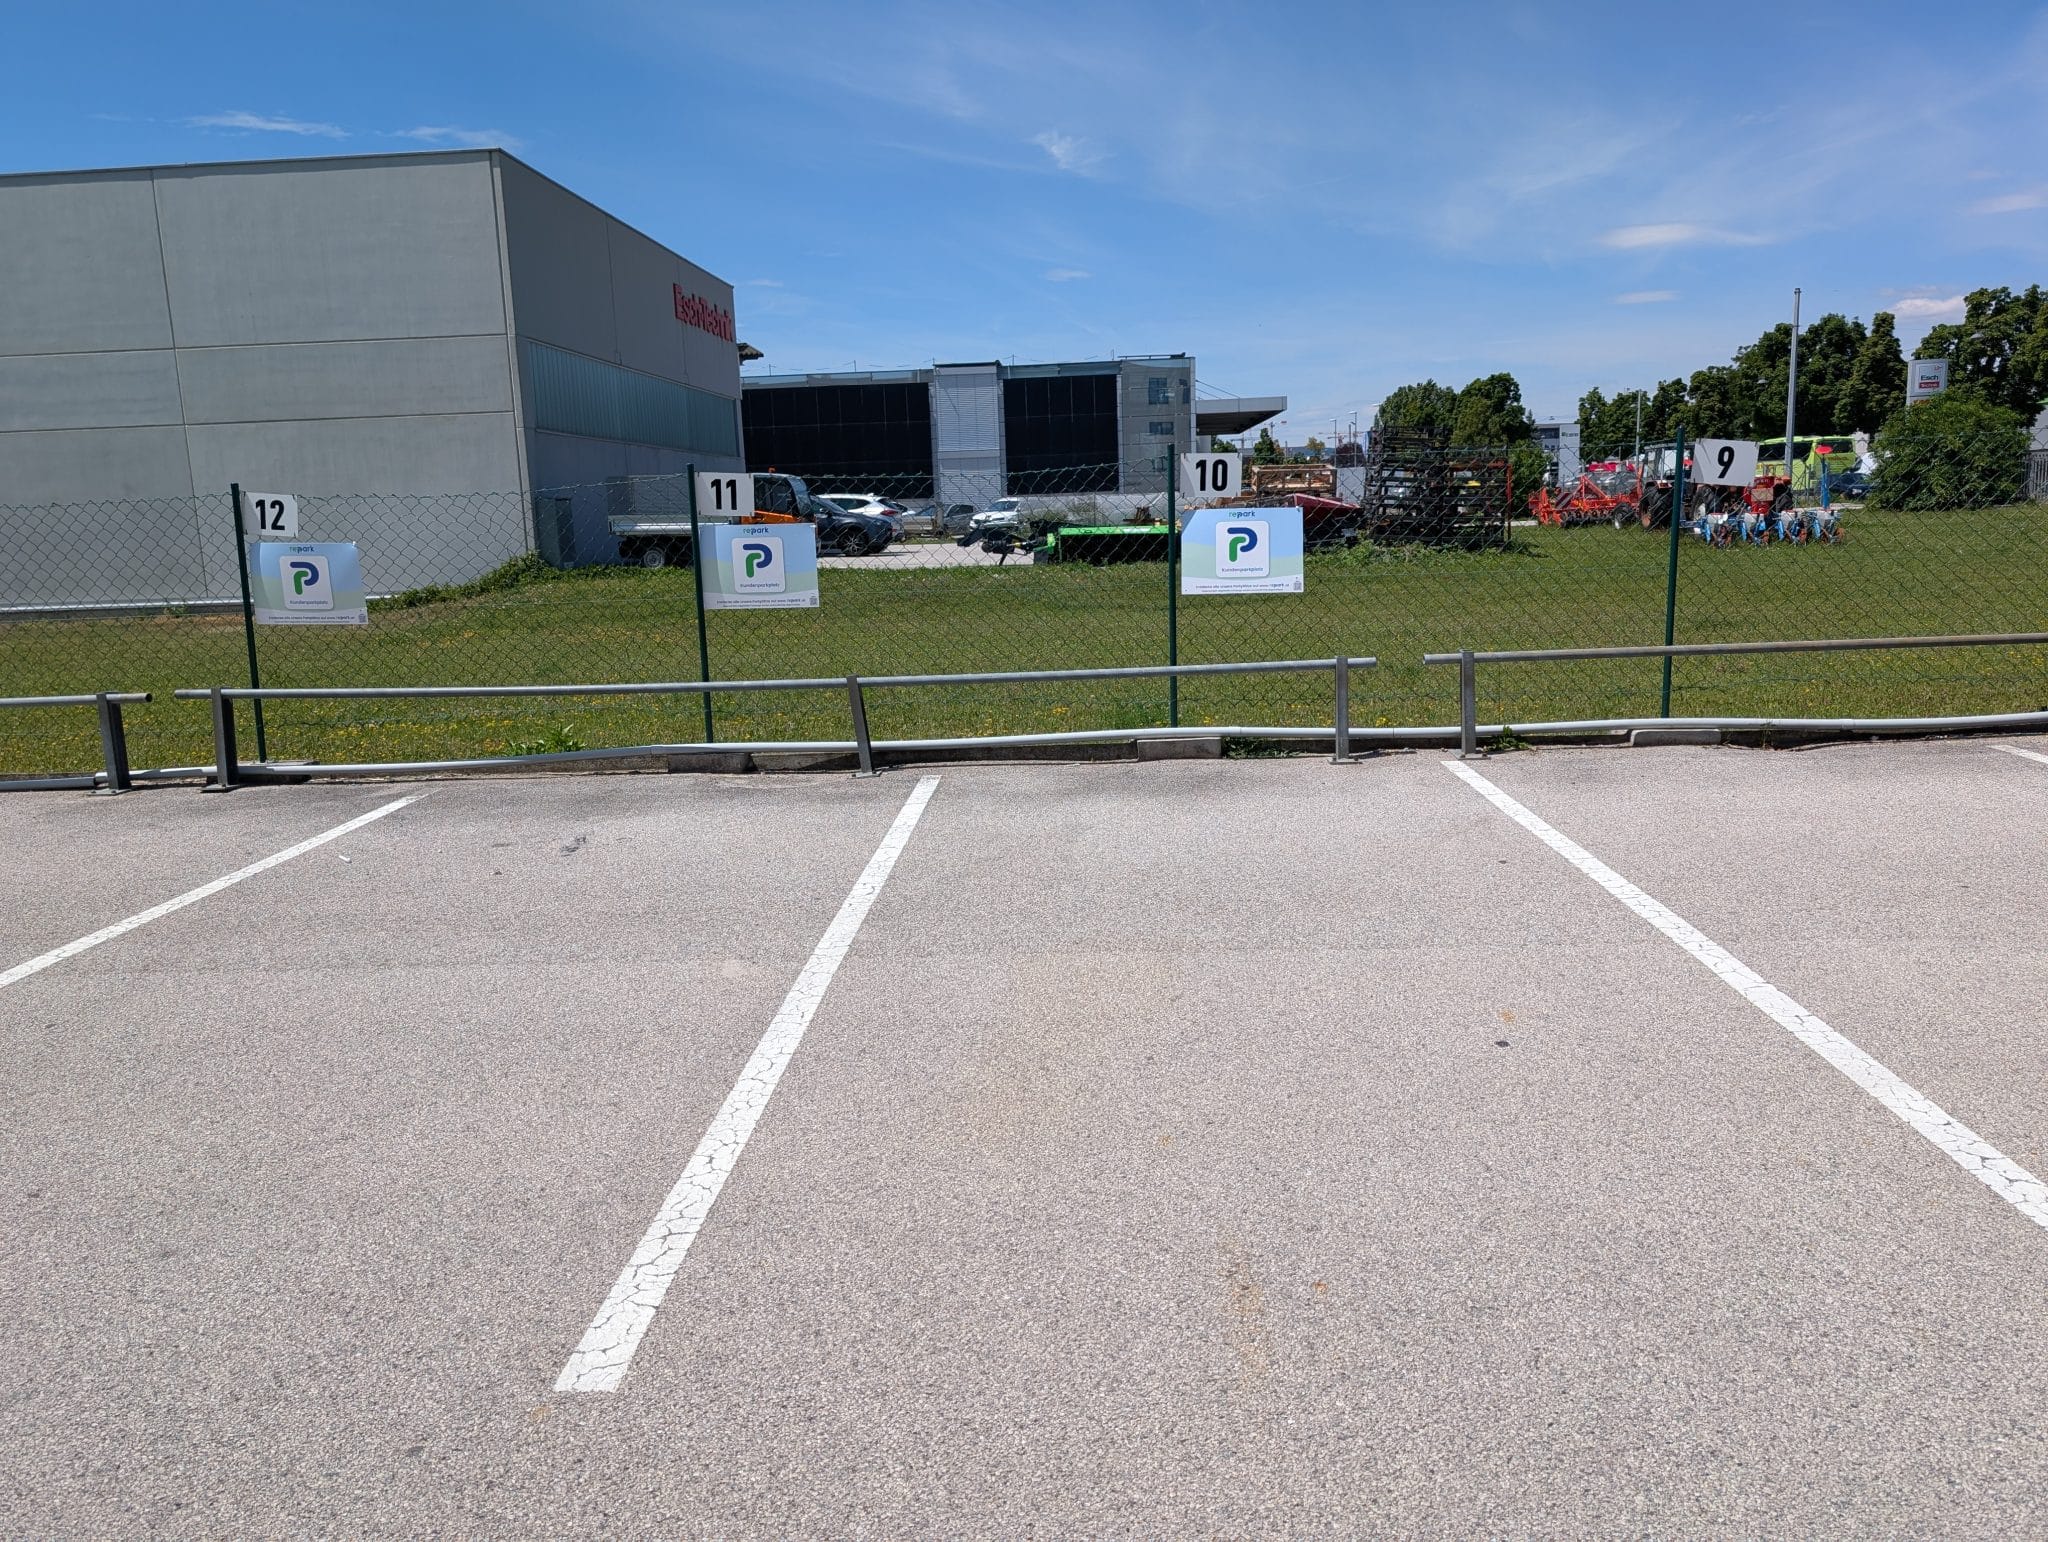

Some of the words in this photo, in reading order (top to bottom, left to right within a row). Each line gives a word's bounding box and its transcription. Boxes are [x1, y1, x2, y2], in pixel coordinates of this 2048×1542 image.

[1195, 458, 1228, 492] 10
[1717, 446, 1735, 479] 9
[710, 478, 738, 511] 11
[255, 499, 286, 531] 12
[743, 526, 769, 535] repark
[1228, 510, 1256, 519] repark
